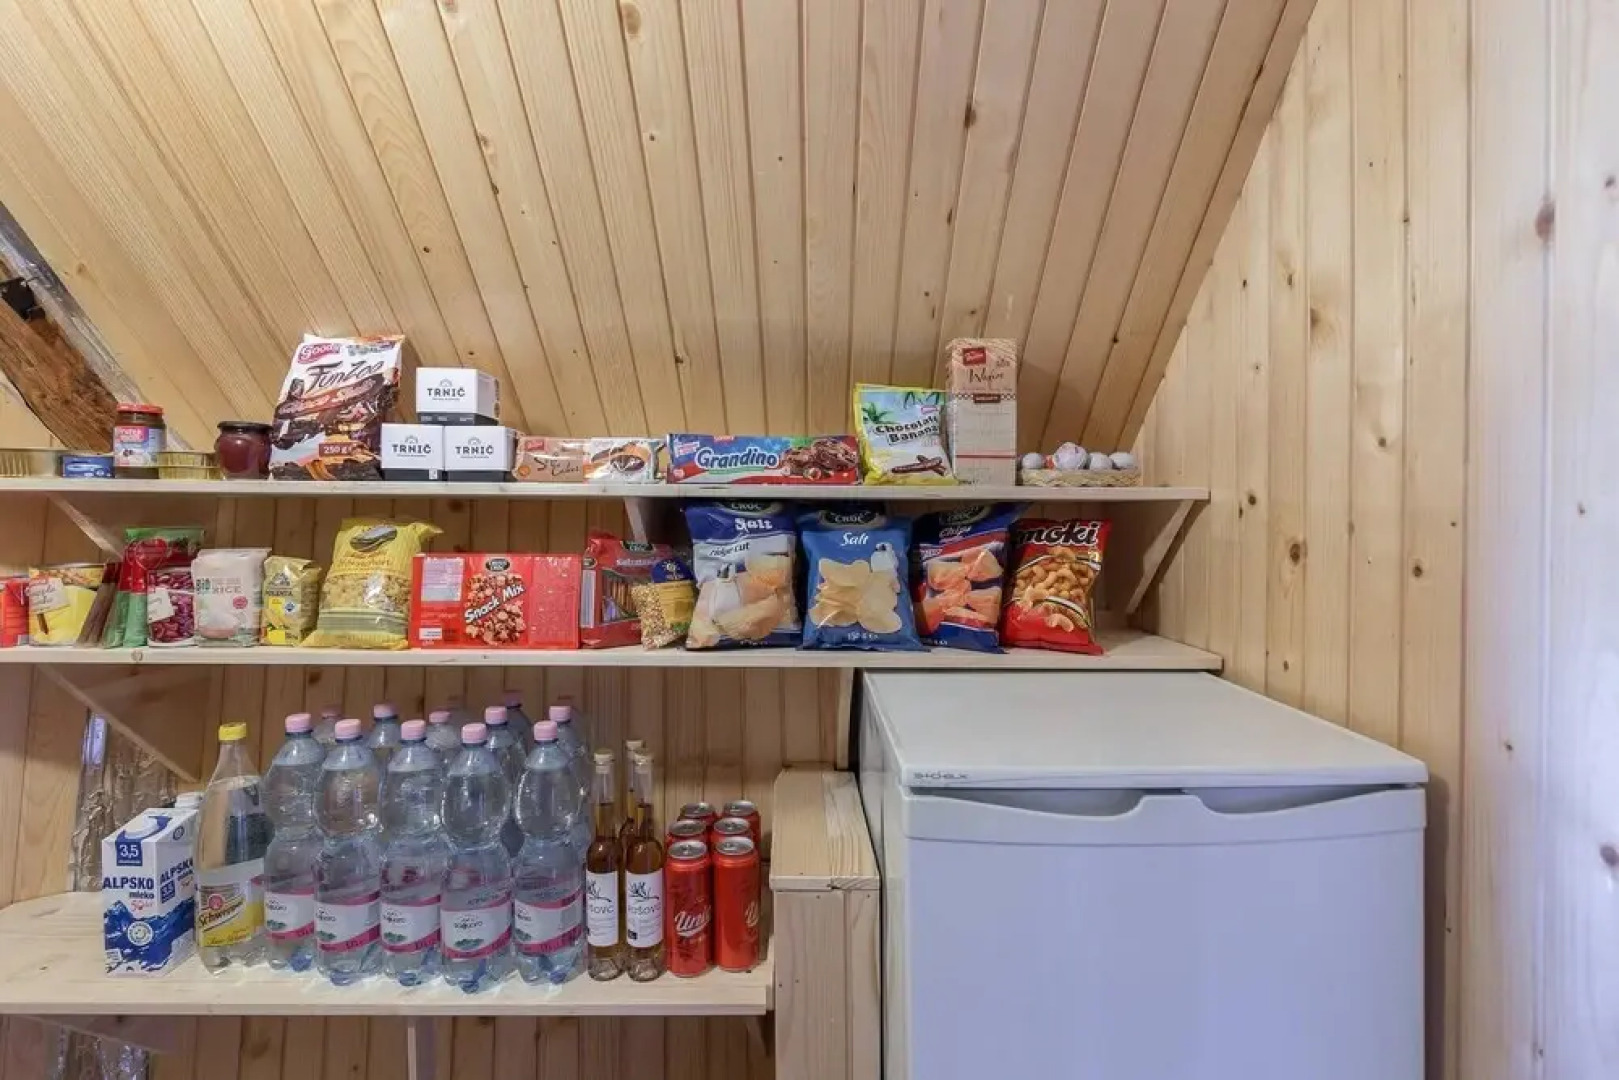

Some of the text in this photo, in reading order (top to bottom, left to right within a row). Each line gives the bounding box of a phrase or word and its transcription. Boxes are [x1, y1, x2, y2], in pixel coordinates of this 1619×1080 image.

[427, 387, 466, 397] TRNIČ
[392, 444, 431, 454] TRNIČ
[455, 445, 495, 454] TRNIČ
[696, 447, 778, 469] Grandino
[840, 532, 869, 547] Salt
[464, 595, 500, 623] Snack
[502, 584, 525, 602] Mix
[103, 876, 155, 890] ALPSKO
